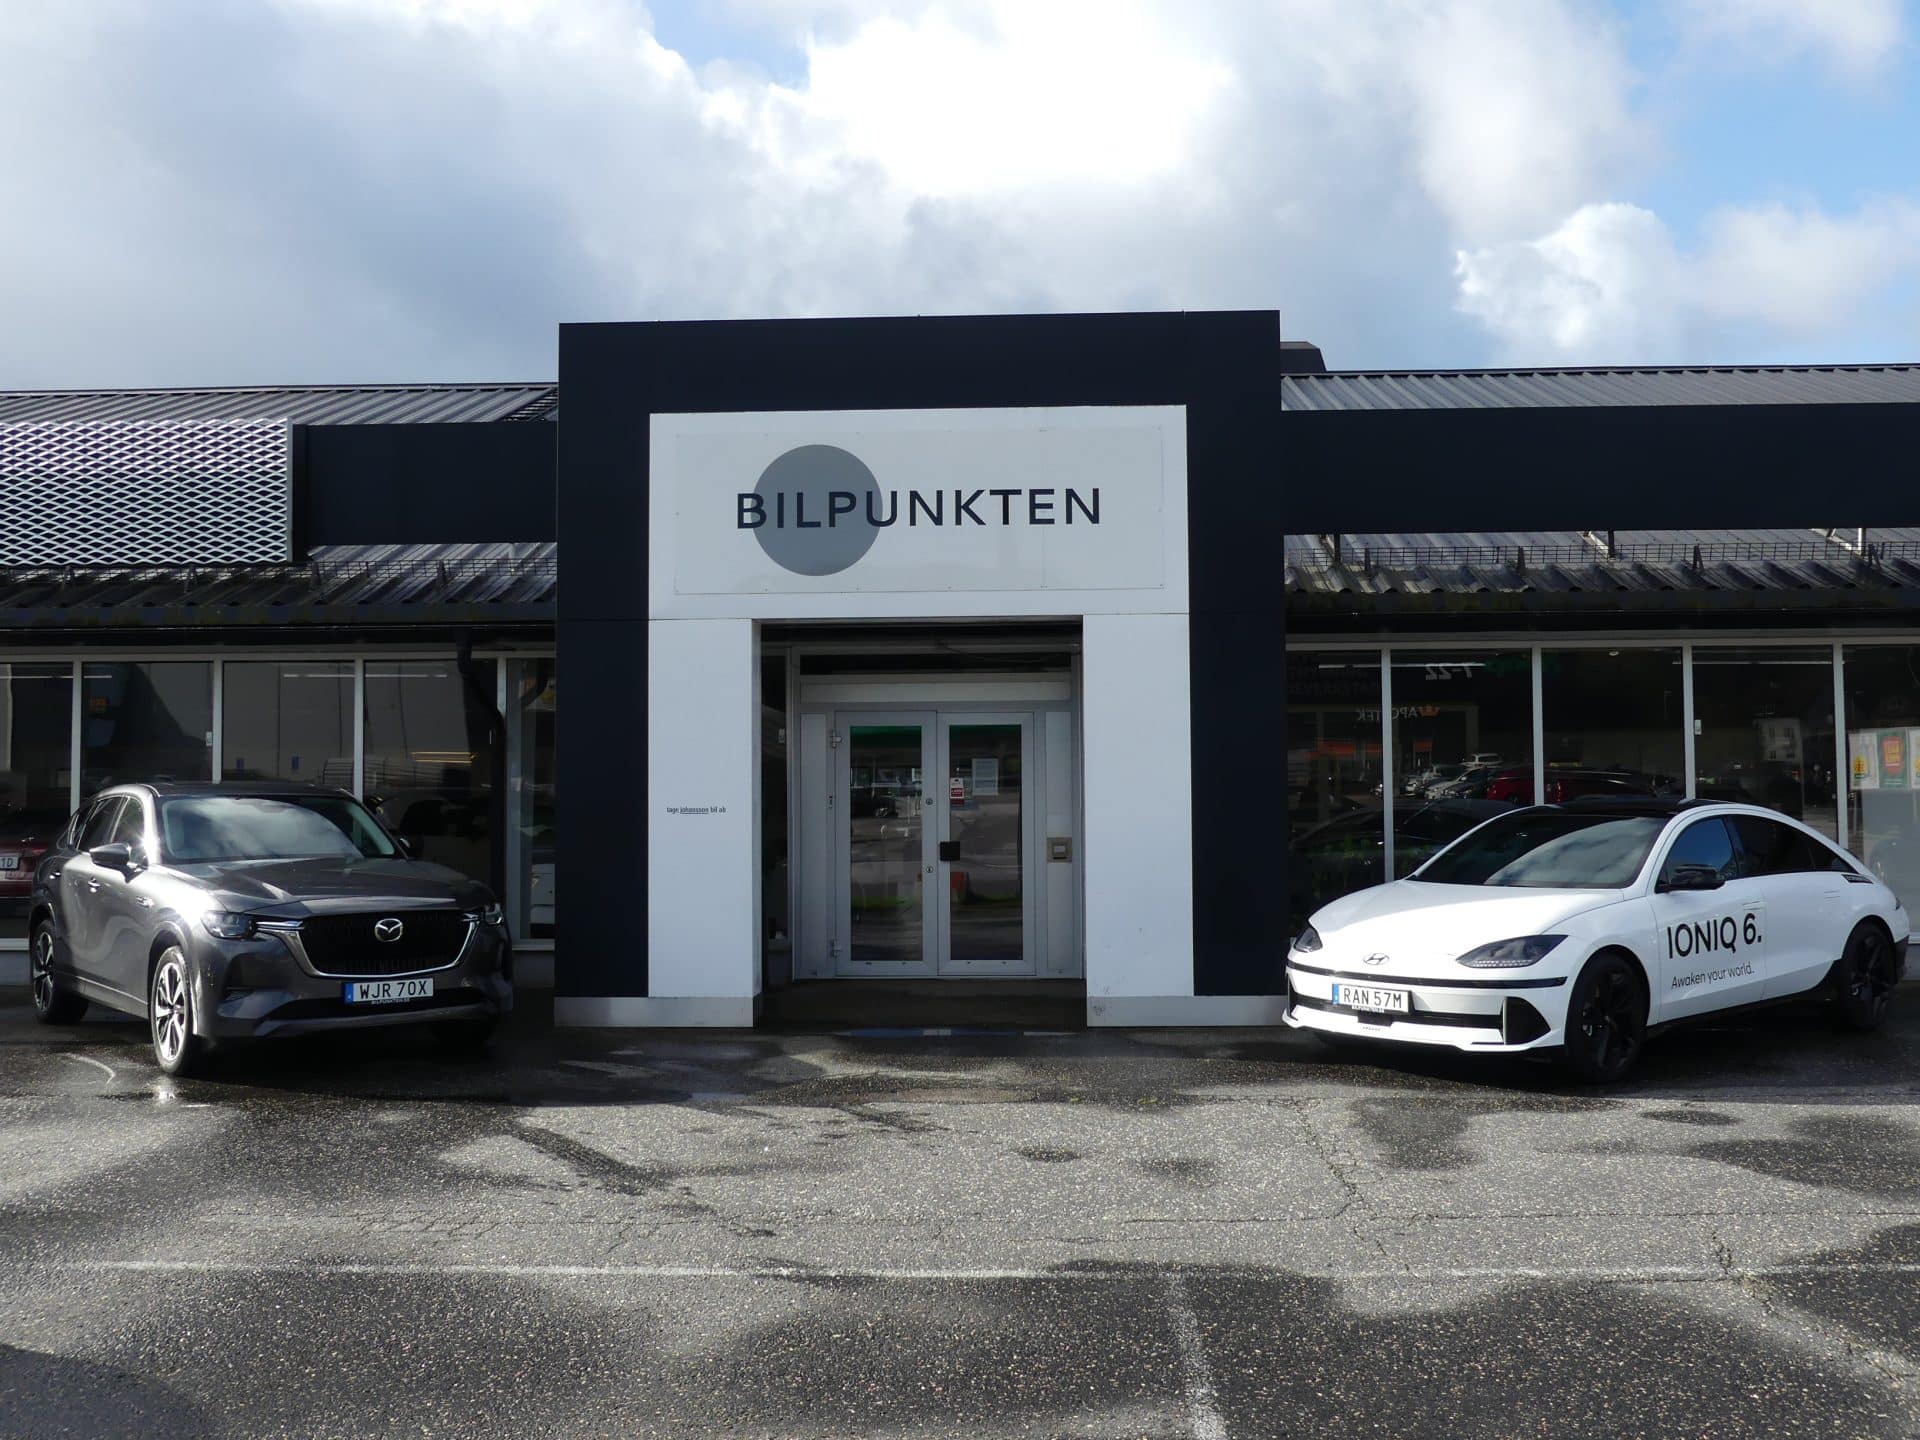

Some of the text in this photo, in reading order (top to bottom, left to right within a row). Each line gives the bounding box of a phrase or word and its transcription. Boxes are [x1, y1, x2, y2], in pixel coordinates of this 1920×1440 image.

[737, 488, 1100, 529] BILPUNKTEN
[1667, 912, 1762, 960] IONIQ 6.
[360, 980, 427, 999] WJR 70X
[1671, 960, 1756, 990] Awaken your world.
[1343, 987, 1369, 1005] RAN
[1374, 991, 1402, 1009] 57M
